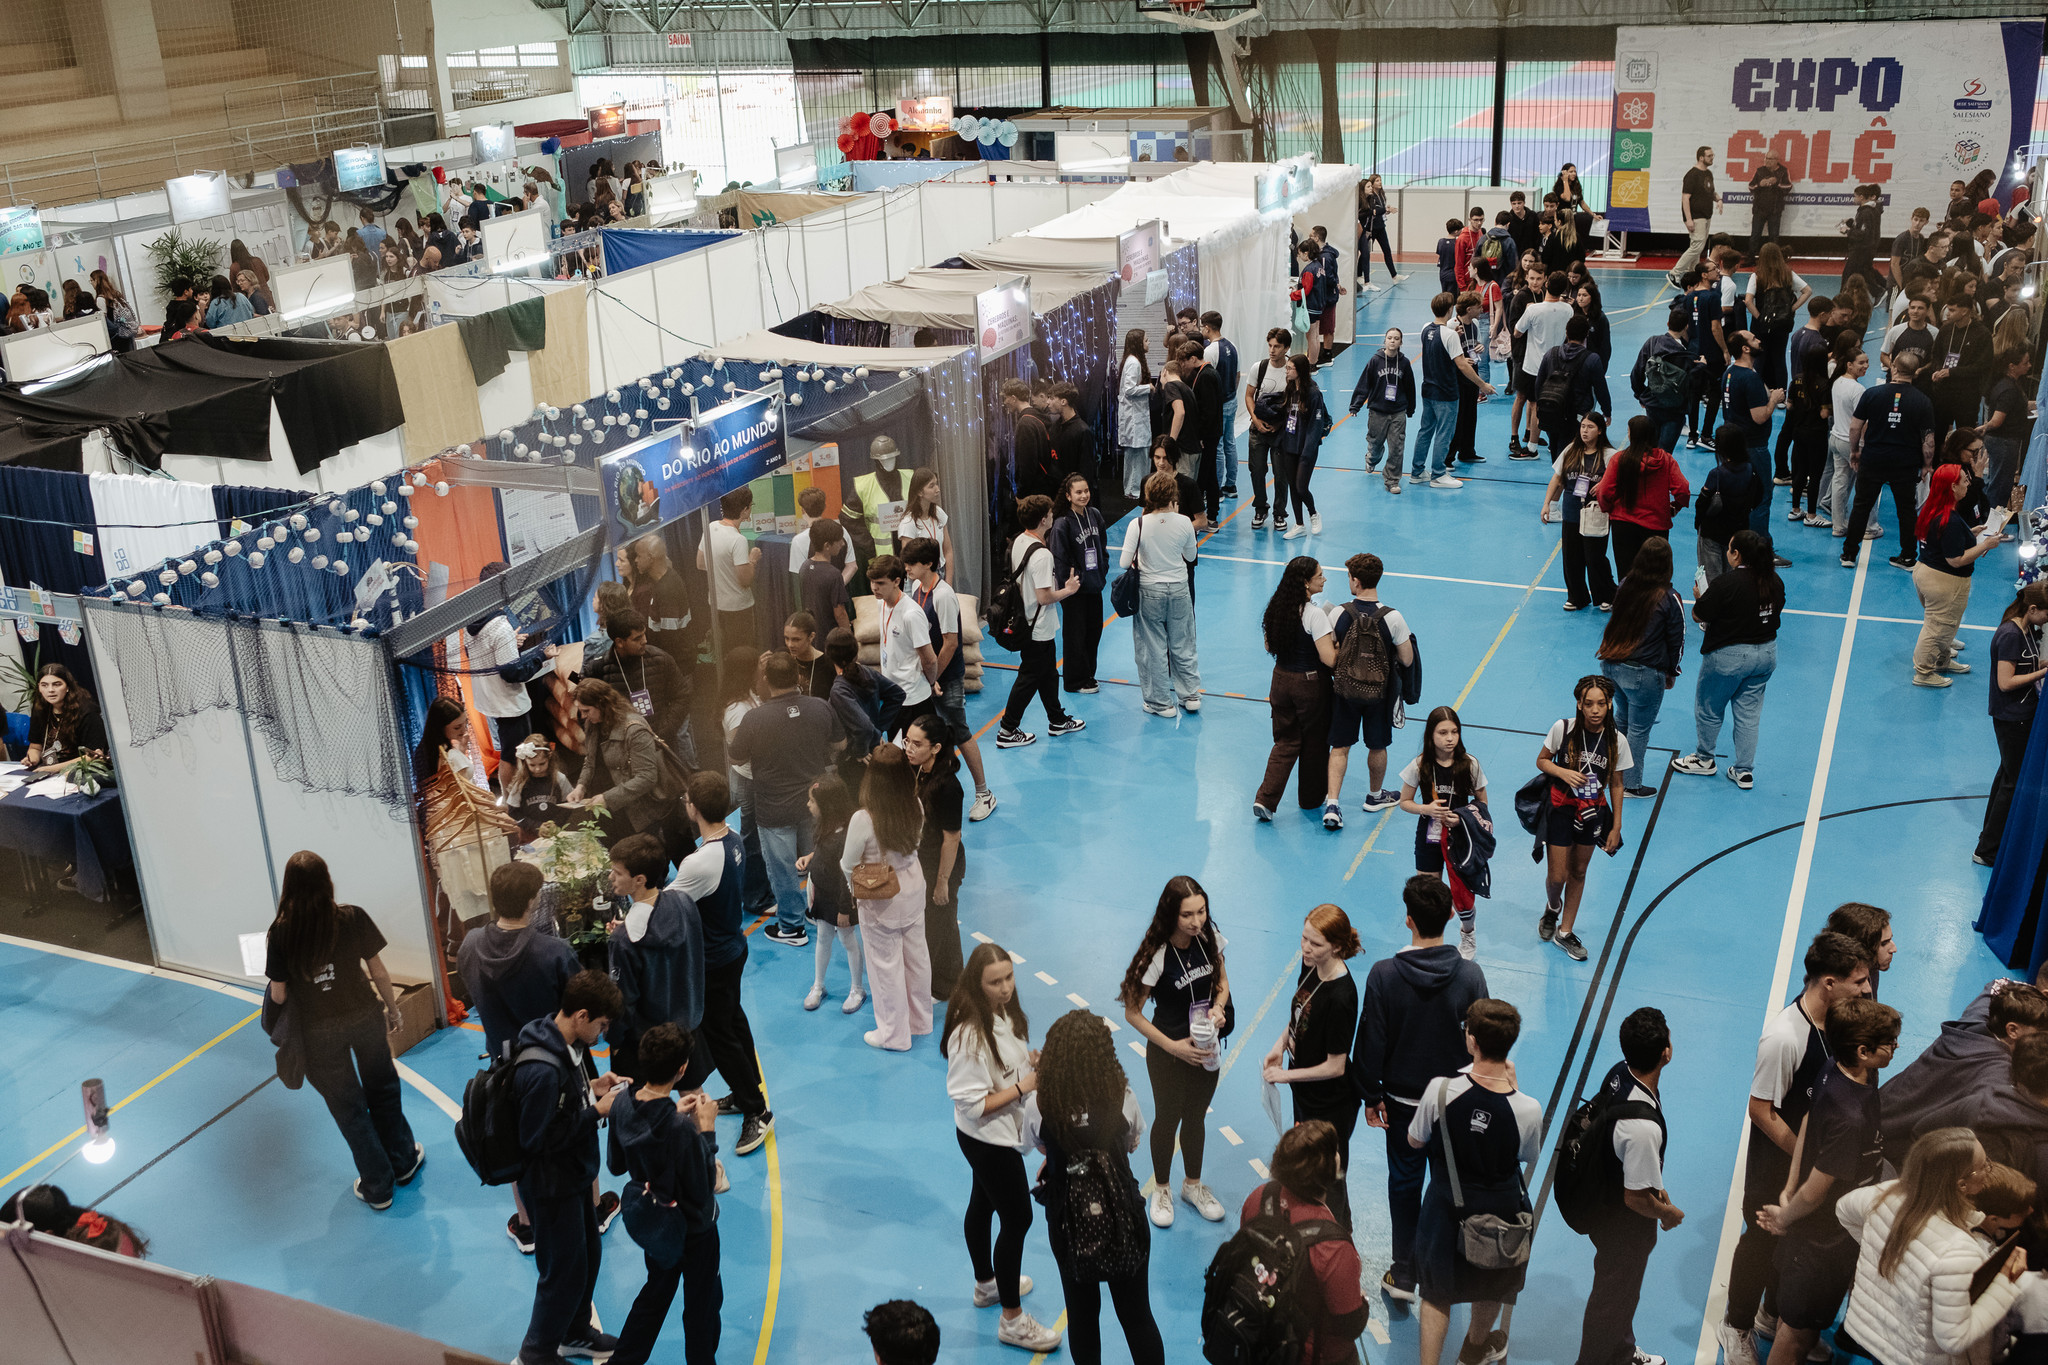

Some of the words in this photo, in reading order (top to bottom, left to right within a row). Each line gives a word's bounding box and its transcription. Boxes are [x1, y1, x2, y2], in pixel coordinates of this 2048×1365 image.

[668, 33, 691, 46] SAÍDA
[1731, 57, 1904, 112] EXPO
[1952, 111, 1991, 119] SALESIANO
[1725, 115, 1896, 184] SOLÊ
[22, 242, 35, 251] ANO
[661, 458, 684, 481] DO
[686, 448, 712, 471] RIO
[713, 438, 730, 460] AO
[731, 420, 778, 451] MUNDO
